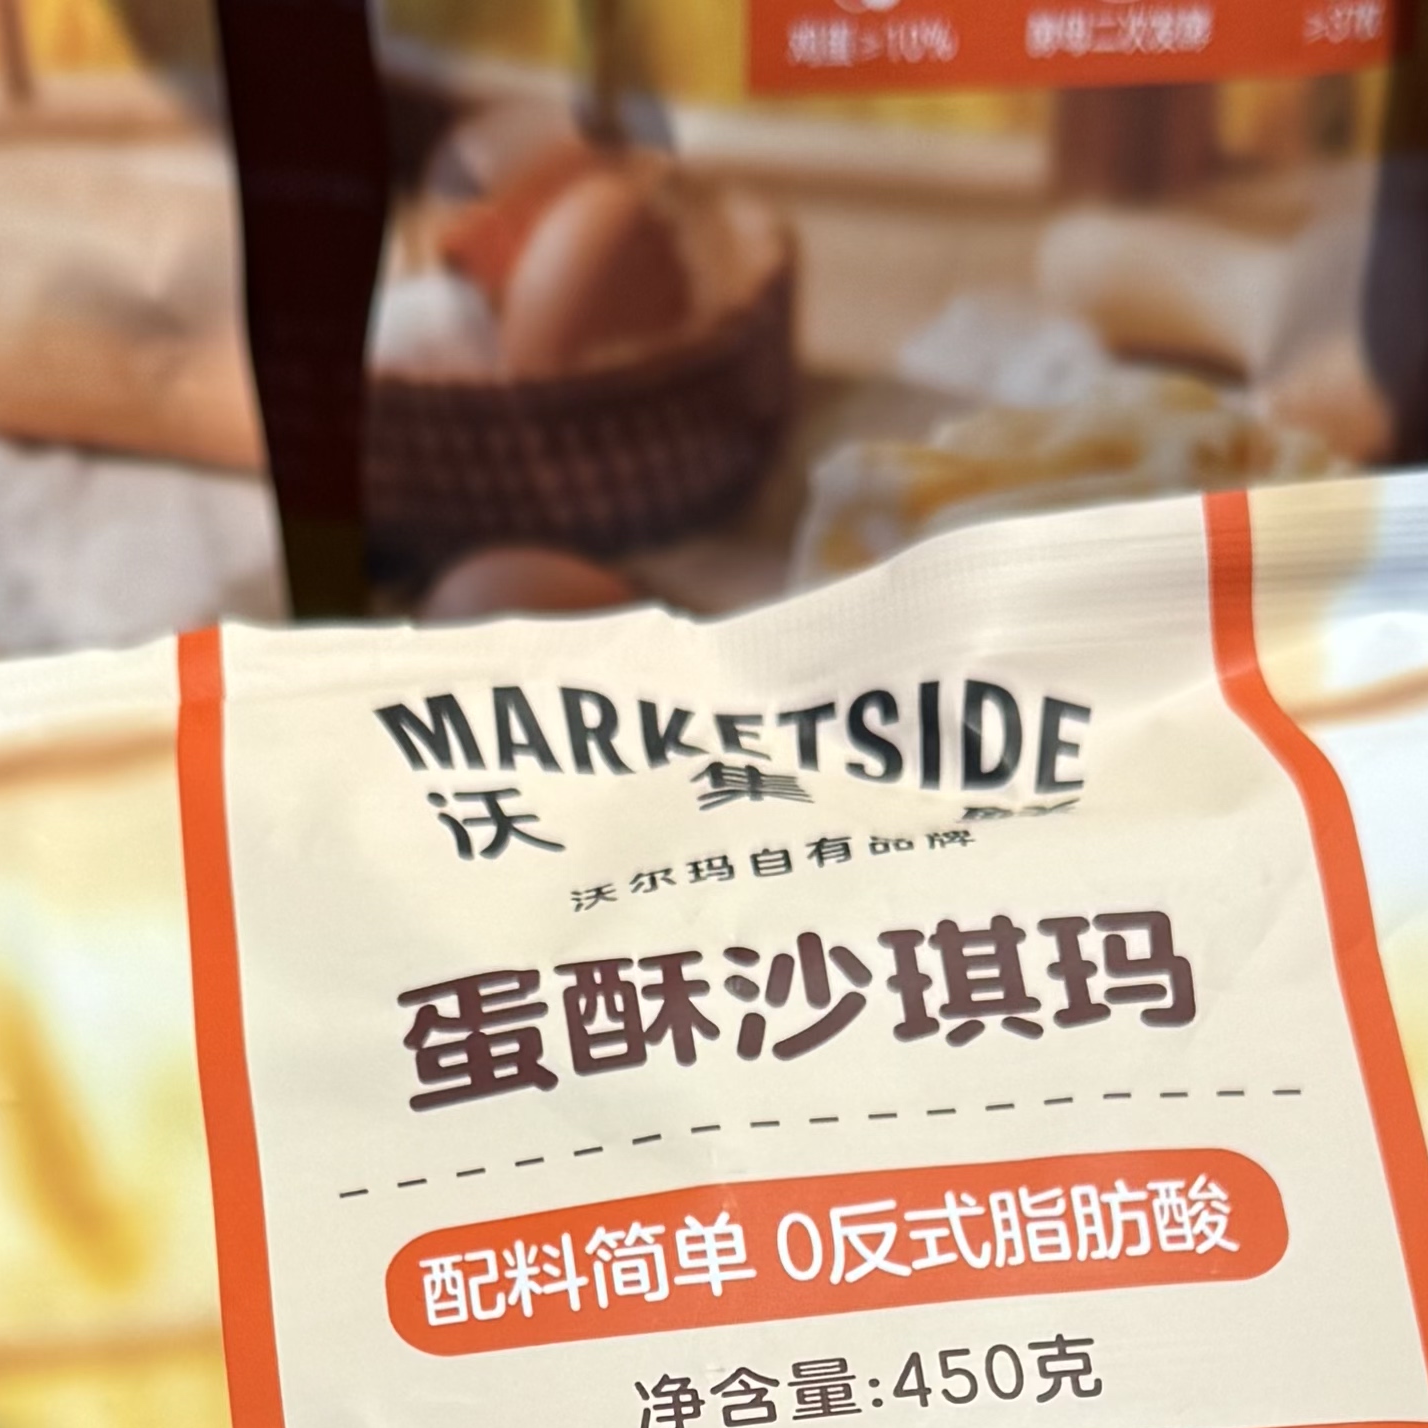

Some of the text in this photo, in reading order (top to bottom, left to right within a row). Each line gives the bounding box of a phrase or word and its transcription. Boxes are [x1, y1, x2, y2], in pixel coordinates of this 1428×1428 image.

[374, 677, 1094, 795] MARKETSIDE
[569, 826, 976, 913] 沃尔玛自有品牌
[395, 907, 1199, 1114] 蛋酥沙琪玛
[419, 1176, 1241, 1329] 配料简单 0反式脂肪酸
